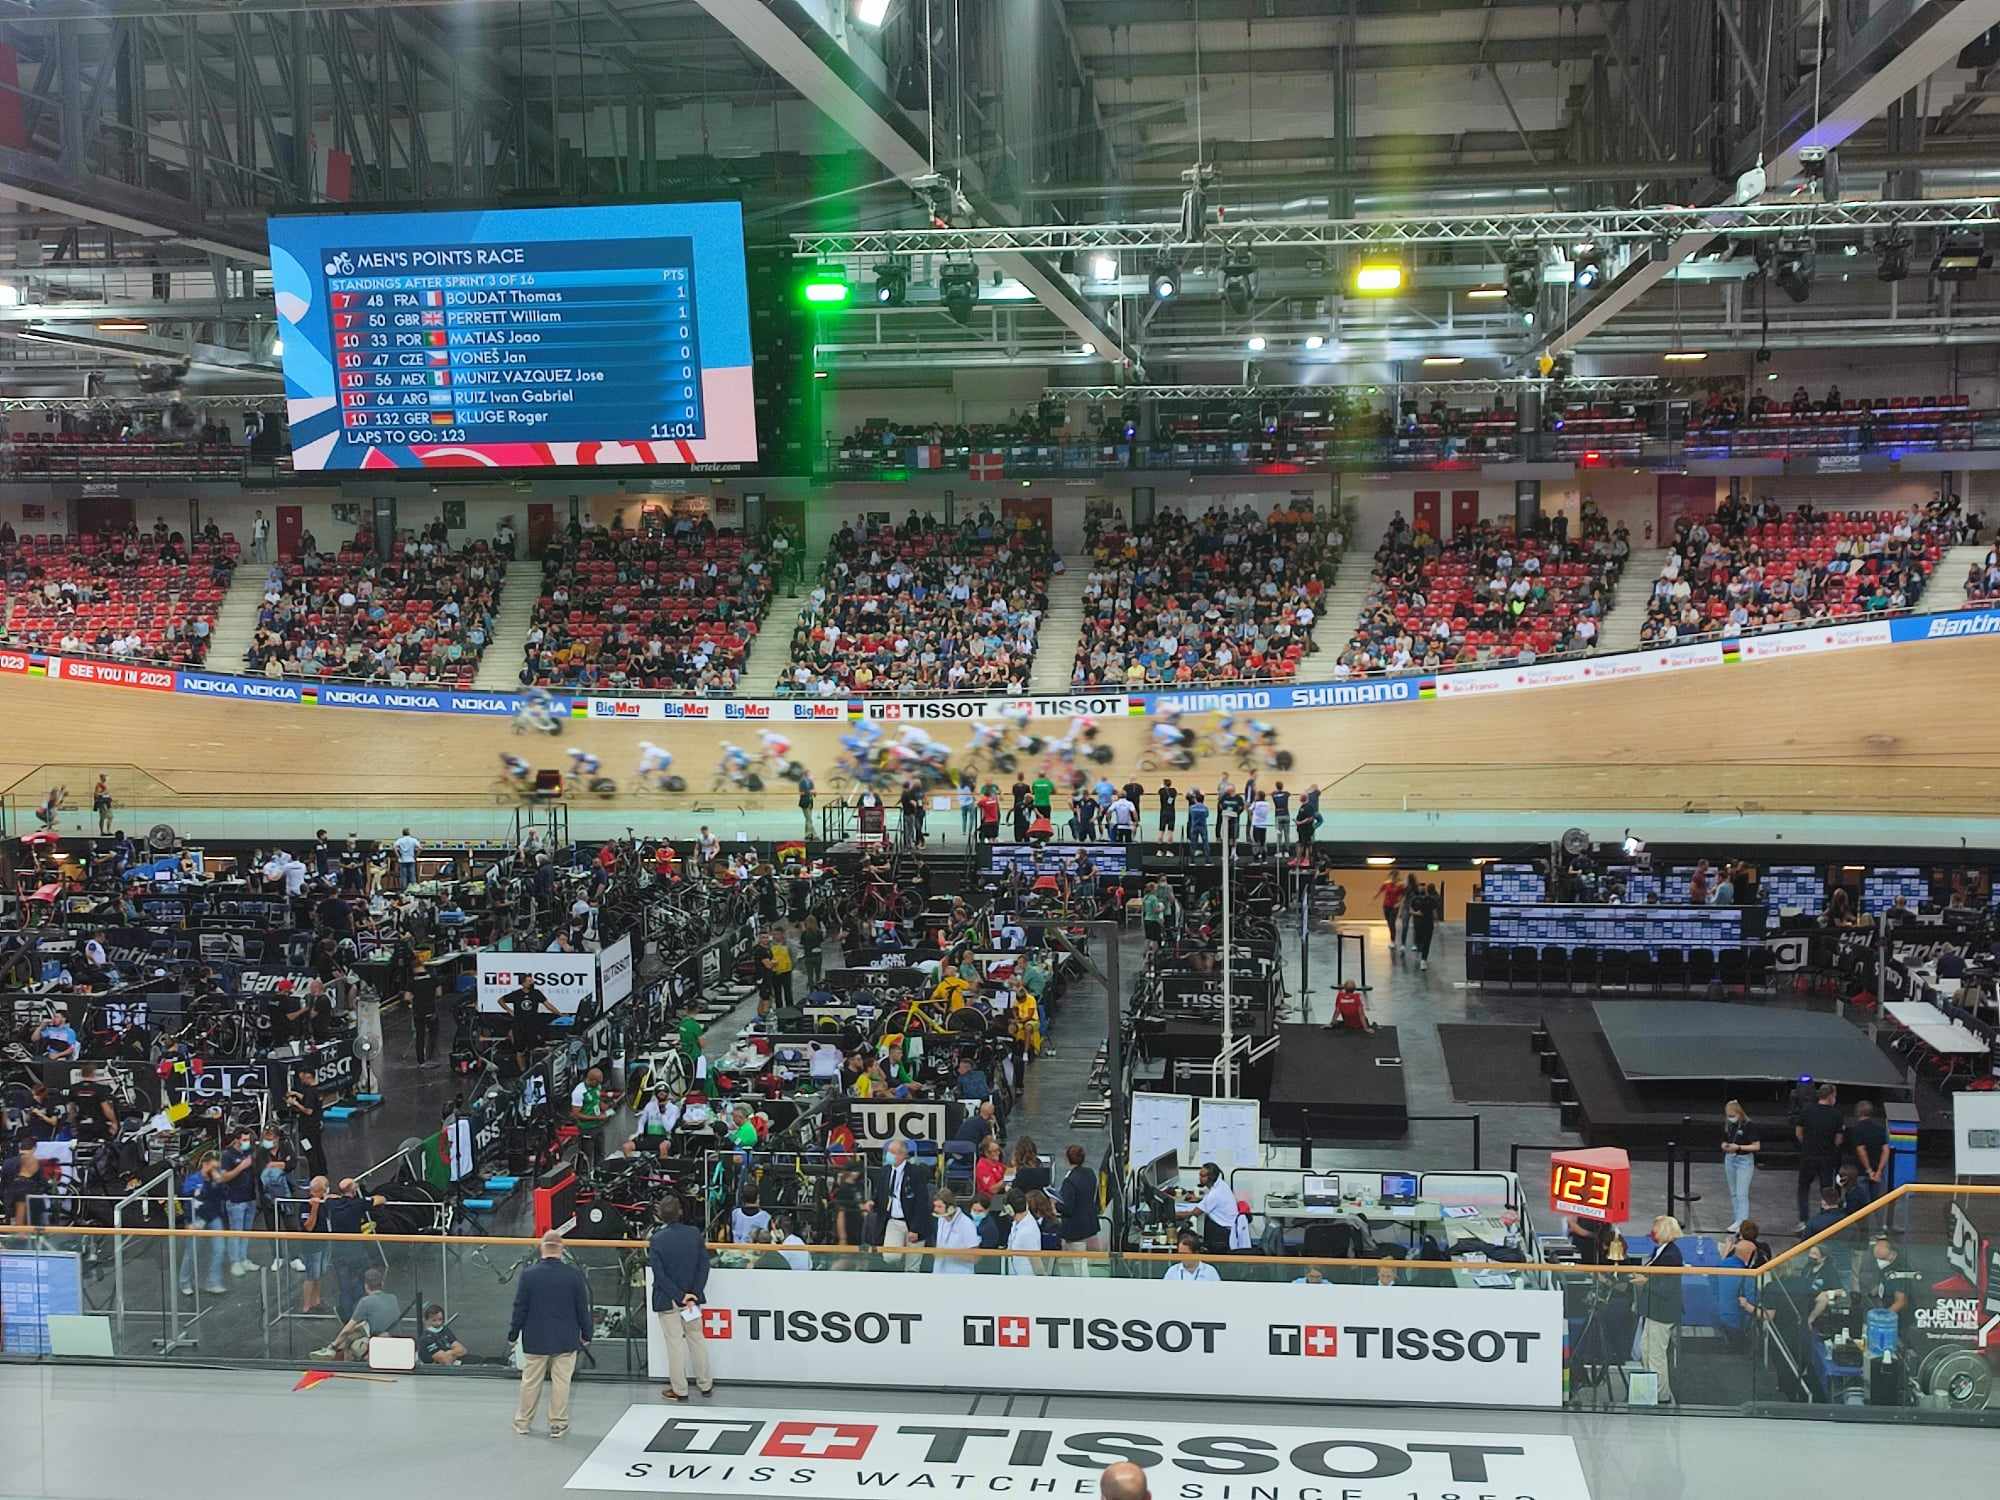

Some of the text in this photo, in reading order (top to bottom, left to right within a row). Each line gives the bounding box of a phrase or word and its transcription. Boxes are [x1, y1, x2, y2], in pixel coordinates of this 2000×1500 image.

[357, 248, 525, 269] MEN'S POINTS RACE
[331, 274, 535, 291] STANDINGS AFTER SPRINT 3 OF 16
[663, 270, 685, 281] PTS
[342, 286, 685, 308] 7 48 FRA BOUDAT Thomas 1
[344, 306, 687, 329] 7 50 GBR PERRETT William 1
[343, 326, 689, 348] 10 33 POR MATIAS Joao 0
[344, 345, 690, 368] 10 47 CZE VONEŠ Jan 0
[347, 366, 692, 388] 10 56 MEX MUNIZ VAZQUEZ Jose 0
[349, 386, 693, 407] 10 64 ARG RUIZ Ivan Gabriel 0
[351, 405, 694, 426] 10 132 GER KLUGE Roger 0
[347, 429, 466, 444] LAPS TO GO: 123
[650, 423, 696, 438] 11:01
[0, 655, 25, 670] 023
[69, 663, 171, 687] SEE YOU IN 2023
[183, 678, 298, 699] NOKIA NOKIA
[1291, 682, 1409, 707] SHIMANO
[325, 691, 440, 709] NOKIA NOKIA
[452, 698, 567, 713] NOKIA NIA
[595, 701, 641, 716] BigMat
[1036, 699, 1121, 716] TISSOT
[664, 703, 709, 719] BigMat
[725, 703, 770, 720] BigMat
[794, 704, 839, 720] BigMat
[903, 703, 988, 719] TISSOT
[1774, 944, 1803, 965] CI
[1178, 993, 1253, 1009] TISSOT
[867, 1111, 938, 1140] UCI
[1554, 1166, 1611, 1206] 123
[1936, 1298, 1980, 1311] SAINT
[1914, 1309, 1978, 1322] QUENTIN
[1917, 1320, 1931, 1329] EN
[738, 1309, 921, 1344] TISSOT
[1036, 1317, 1227, 1353] TISSOT
[1343, 1326, 1541, 1363] TISSOT
[897, 1425, 1524, 1482] TISSOT
[625, 1463, 816, 1484] SWISS
[856, 1471, 1105, 1495] WATCHE
